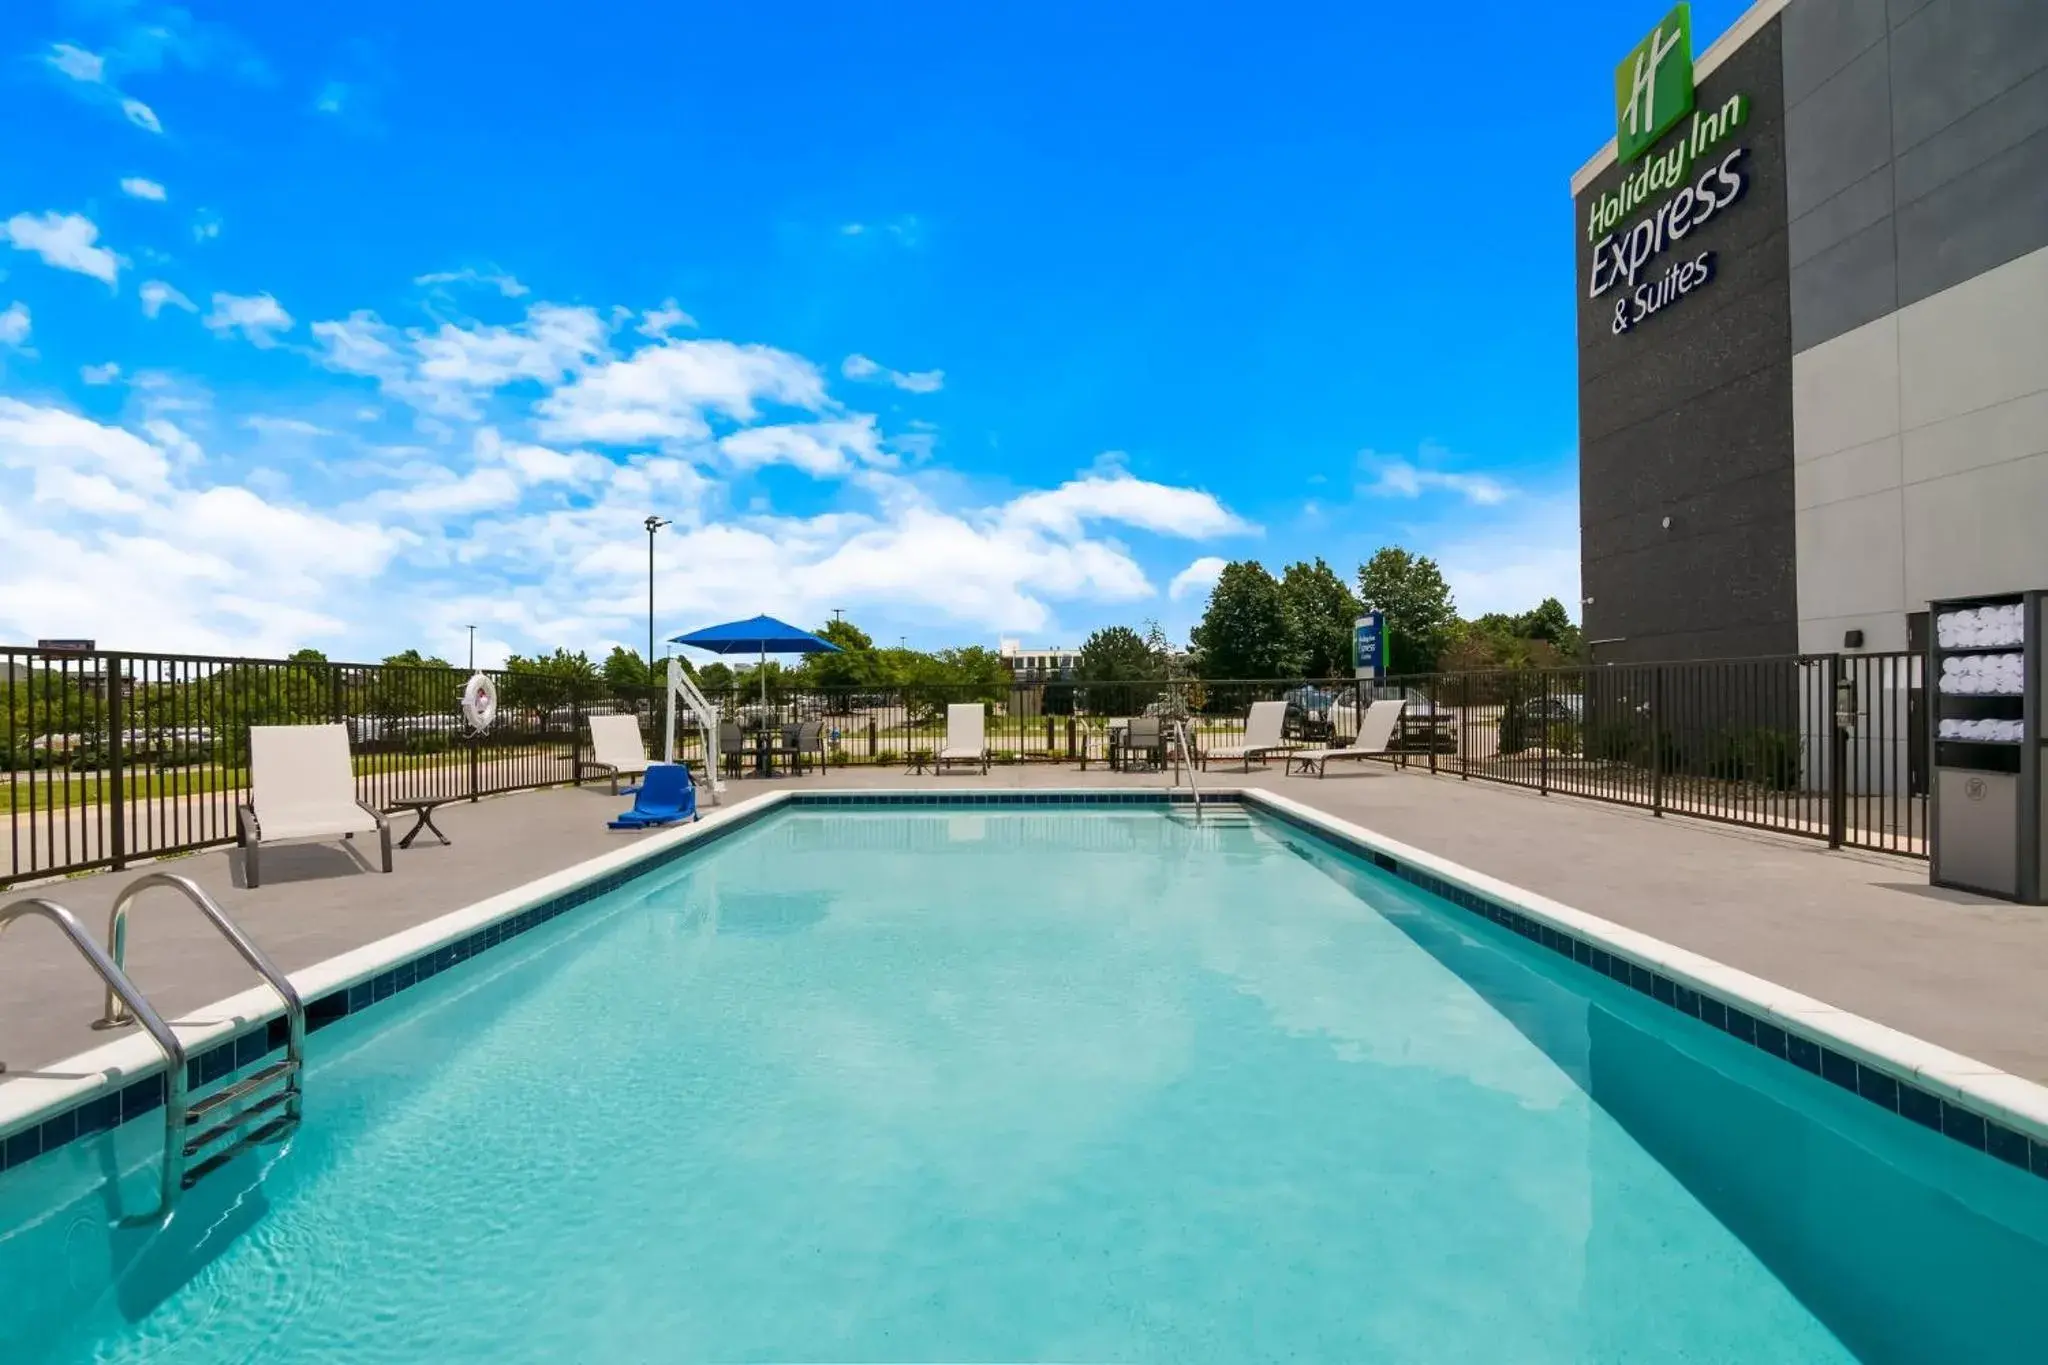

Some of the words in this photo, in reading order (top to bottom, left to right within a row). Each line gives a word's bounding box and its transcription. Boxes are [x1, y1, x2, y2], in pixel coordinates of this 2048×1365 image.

[1623, 28, 1680, 134] H
[1588, 139, 1684, 242] Holiday
[1690, 94, 1740, 159] Inn
[1589, 149, 1741, 298] Express
[1612, 297, 1627, 334] &
[1632, 251, 1708, 323] Suites
